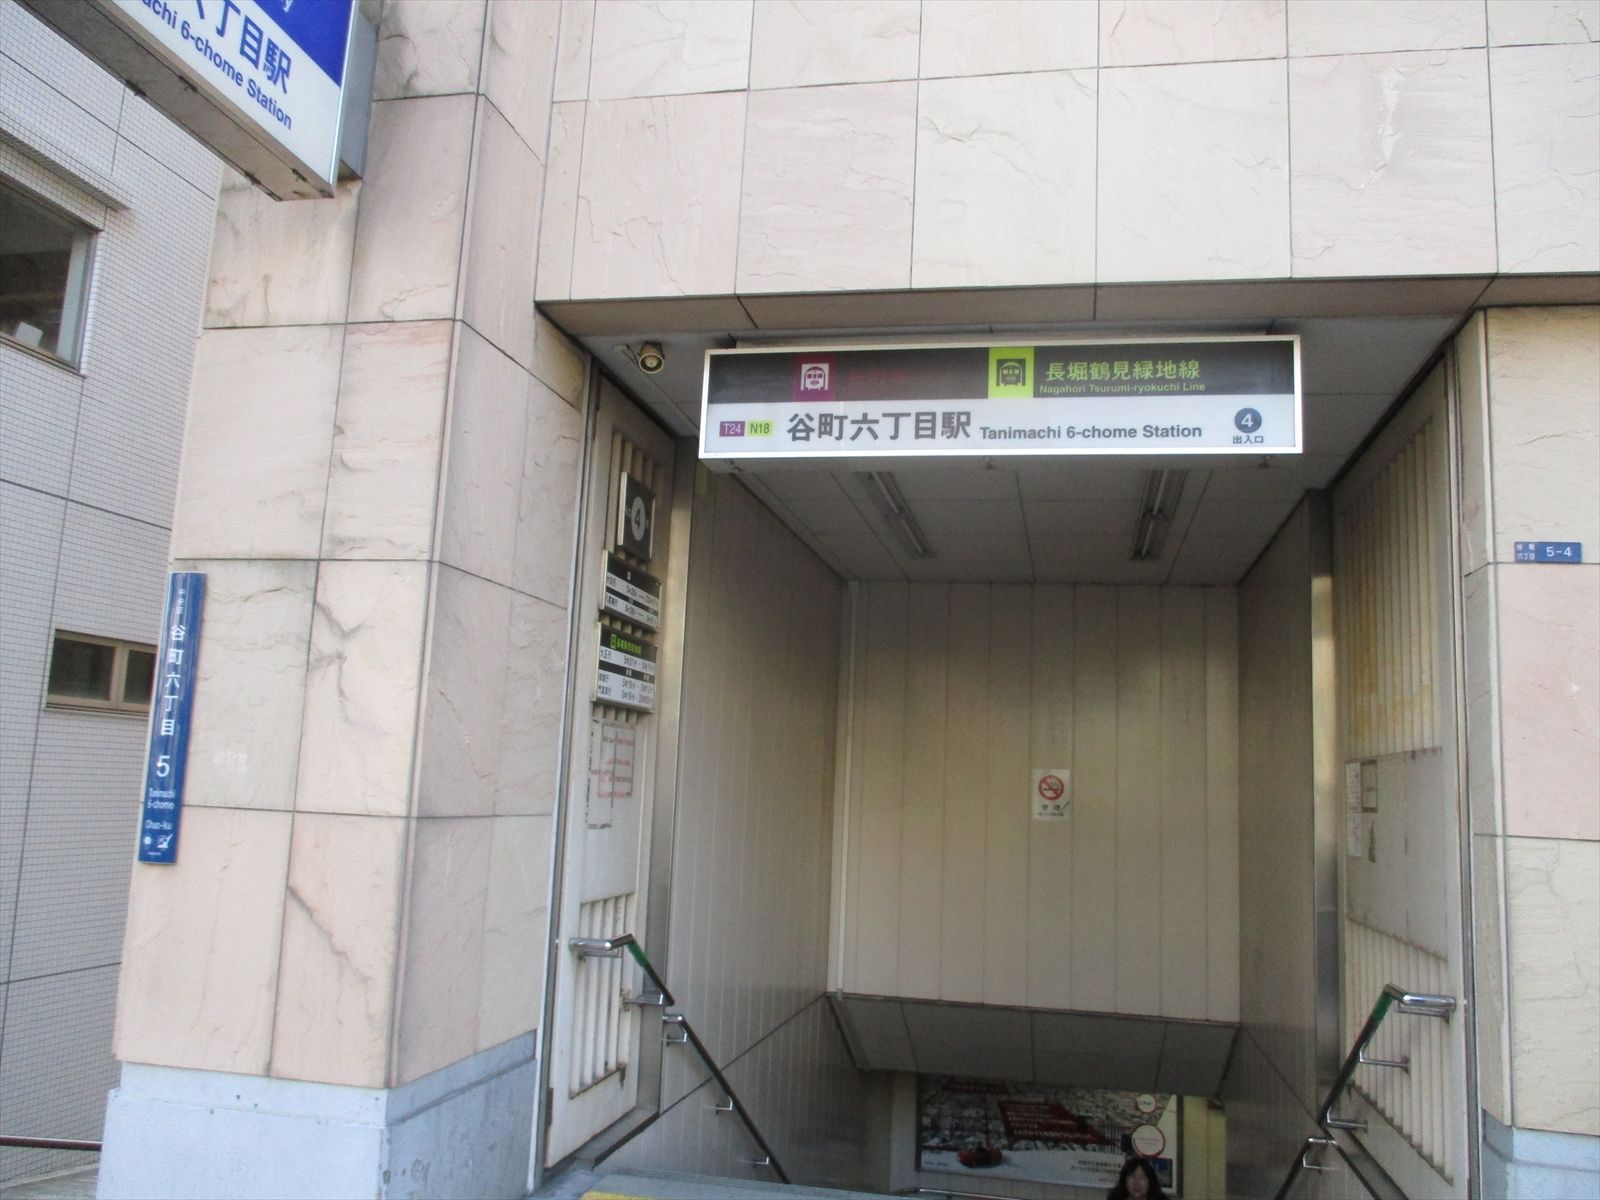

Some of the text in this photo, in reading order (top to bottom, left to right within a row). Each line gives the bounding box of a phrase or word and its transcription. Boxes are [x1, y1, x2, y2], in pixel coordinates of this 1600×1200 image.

[180, 21, 243, 86] 6-chome
[247, 79, 293, 130] Station
[1046, 360, 1200, 381] 長堀鶴見緑地線
[1039, 382, 1206, 395] Nagahori Tsurumi-ryokuchi Line
[787, 411, 971, 441] 谷町六丁目駅
[1240, 413, 1253, 427] 4
[723, 423, 742, 435] T24
[750, 422, 770, 434] N18
[980, 424, 1202, 440] Tanimachi 6-chome Station
[1233, 435, 1264, 444] 出入口
[1546, 546, 1572, 557] 5-4
[161, 624, 186, 736] 谷町六丁目
[157, 755, 171, 777] 5
